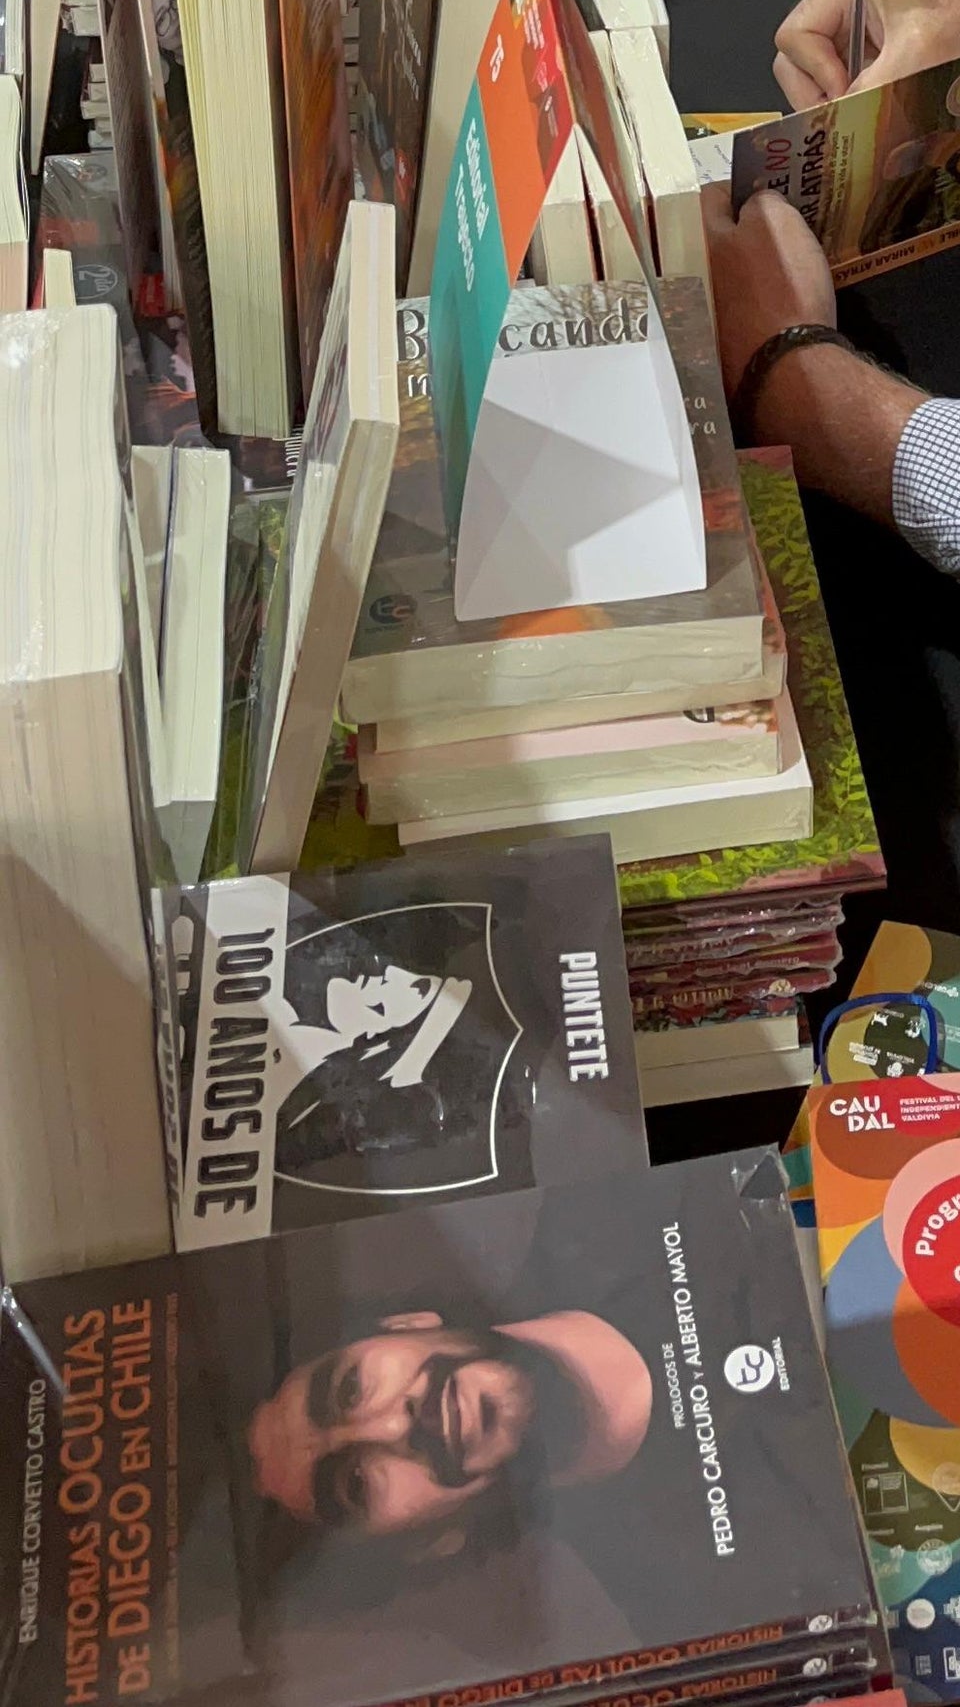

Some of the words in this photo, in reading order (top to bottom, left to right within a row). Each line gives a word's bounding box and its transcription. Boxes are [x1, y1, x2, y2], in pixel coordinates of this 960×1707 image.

[465, 117, 490, 241] Editorial
[765, 138, 792, 174] NO
[797, 130, 826, 196] ATRÁS
[454, 162, 476, 292] Trayecto
[874, 245, 915, 273] MIRAR
[211, 927, 276, 1005] 100
[558, 950, 610, 1084] PUNTETE
[201, 1017, 281, 1142] AÑOS
[829, 1095, 881, 1117] CAU
[900, 1097, 937, 1106] FESTIVAL
[939, 1095, 956, 1104] DEL
[847, 1112, 895, 1133] DAL
[901, 1112, 941, 1122] VALDIVIA
[194, 1151, 258, 1219] DE
[663, 1221, 690, 1283] MAYOL
[110, 1298, 152, 1421] CHILE
[662, 1342, 673, 1360] DE
[674, 1287, 702, 1367] ALBERTO
[772, 1337, 790, 1391] EDITORIAL
[26, 1377, 47, 1451] CASTRO
[58, 1308, 106, 1514] OCULTAS
[690, 1385, 722, 1483] CARCURO
[120, 1426, 151, 1474] EN
[22, 1454, 44, 1553] CORVETTO
[707, 1486, 735, 1557] PEDRO
[107, 1482, 152, 1639] DIEGO
[18, 1554, 40, 1644] ENRIQUE
[66, 1521, 101, 1705] HISTORIAS
[118, 1641, 151, 1695] DE
[561, 1648, 680, 1684] OCULTAS
[687, 1625, 783, 1655] HISTORIAS
[681, 1669, 778, 1698] HISTORIAS
